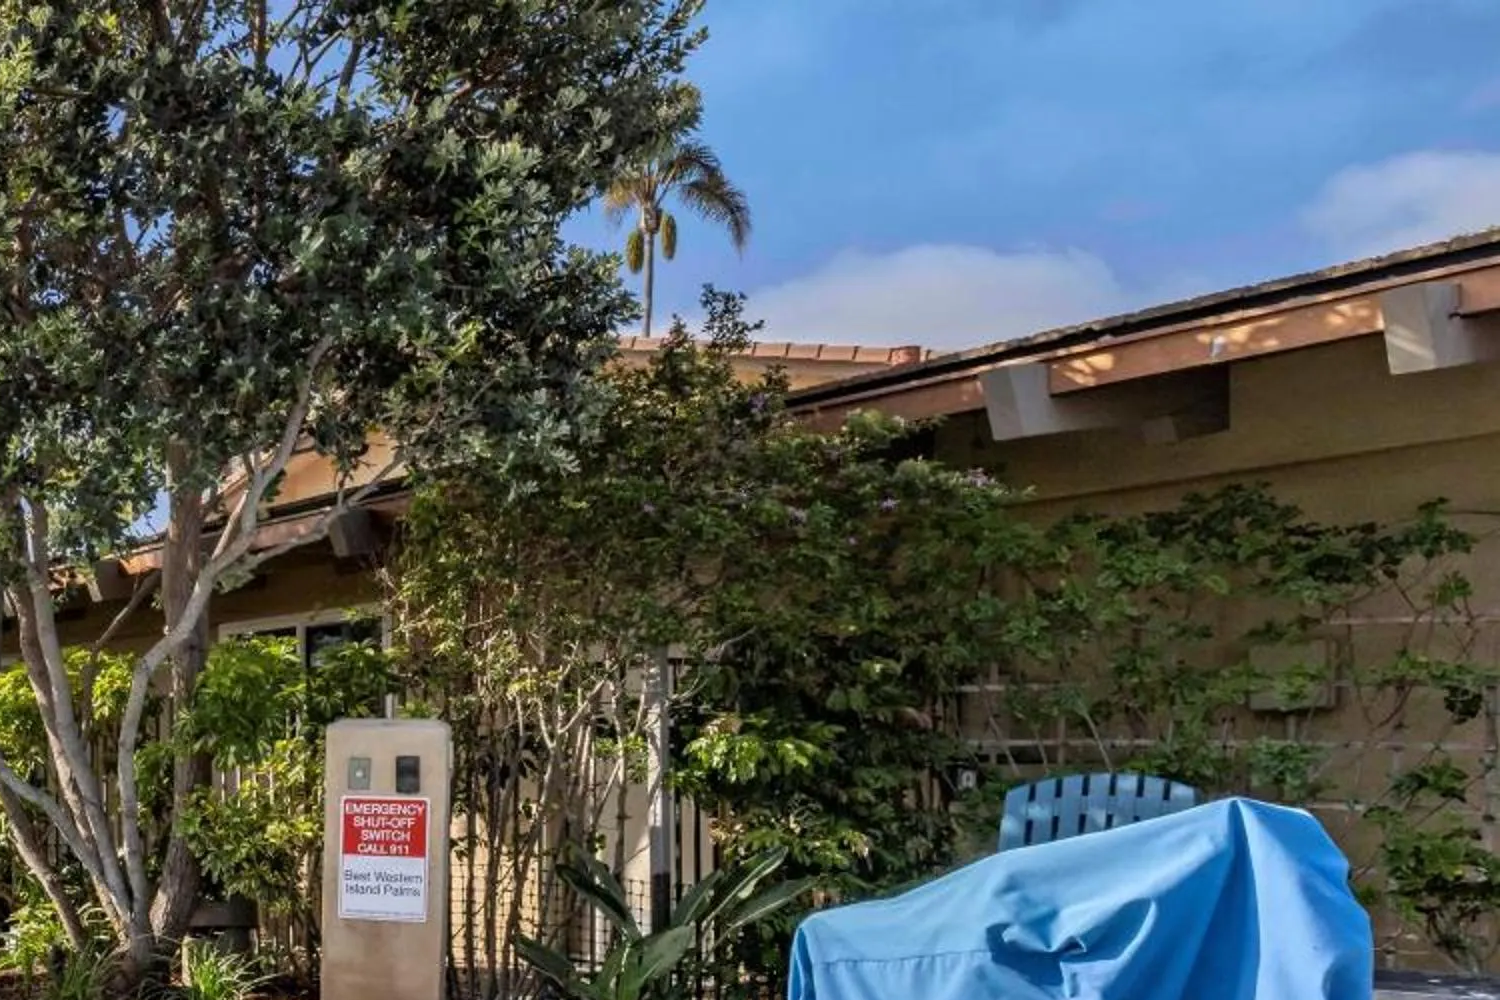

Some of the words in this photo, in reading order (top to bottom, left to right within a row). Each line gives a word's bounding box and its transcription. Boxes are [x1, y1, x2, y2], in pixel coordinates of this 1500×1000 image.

[345, 803, 425, 816] EMERGENCY
[353, 815, 416, 828] SHUT-OFF
[361, 829, 411, 842] SWITCH
[357, 843, 388, 854] CALL
[389, 844, 410, 855] 911
[344, 869, 371, 881] Best
[373, 871, 423, 884] Western
[345, 883, 381, 895] Island
[383, 884, 421, 897] Palms
